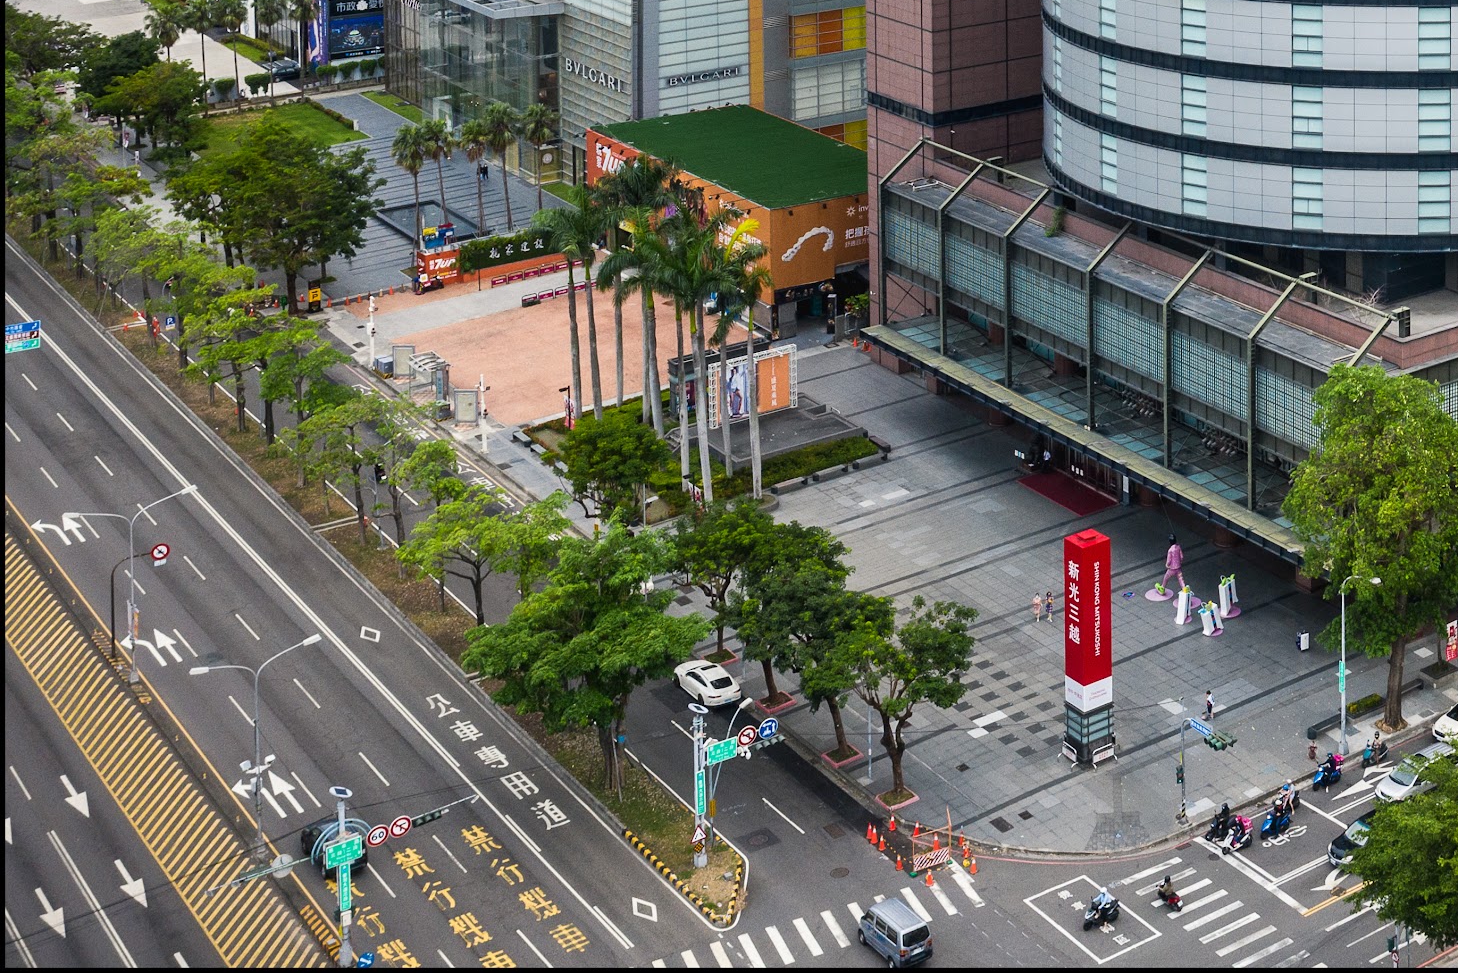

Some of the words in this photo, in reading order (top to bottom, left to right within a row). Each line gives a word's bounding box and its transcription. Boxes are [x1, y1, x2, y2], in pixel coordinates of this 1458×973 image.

[564, 57, 624, 94] BVLGARI
[668, 67, 740, 87] BVLGARI
[1093, 561, 1101, 582] SHIN
[1068, 559, 1081, 645] 新光三越
[425, 693, 571, 830] 公車專用道
[371, 830, 385, 842] 60
[460, 825, 590, 954] 禁行機車
